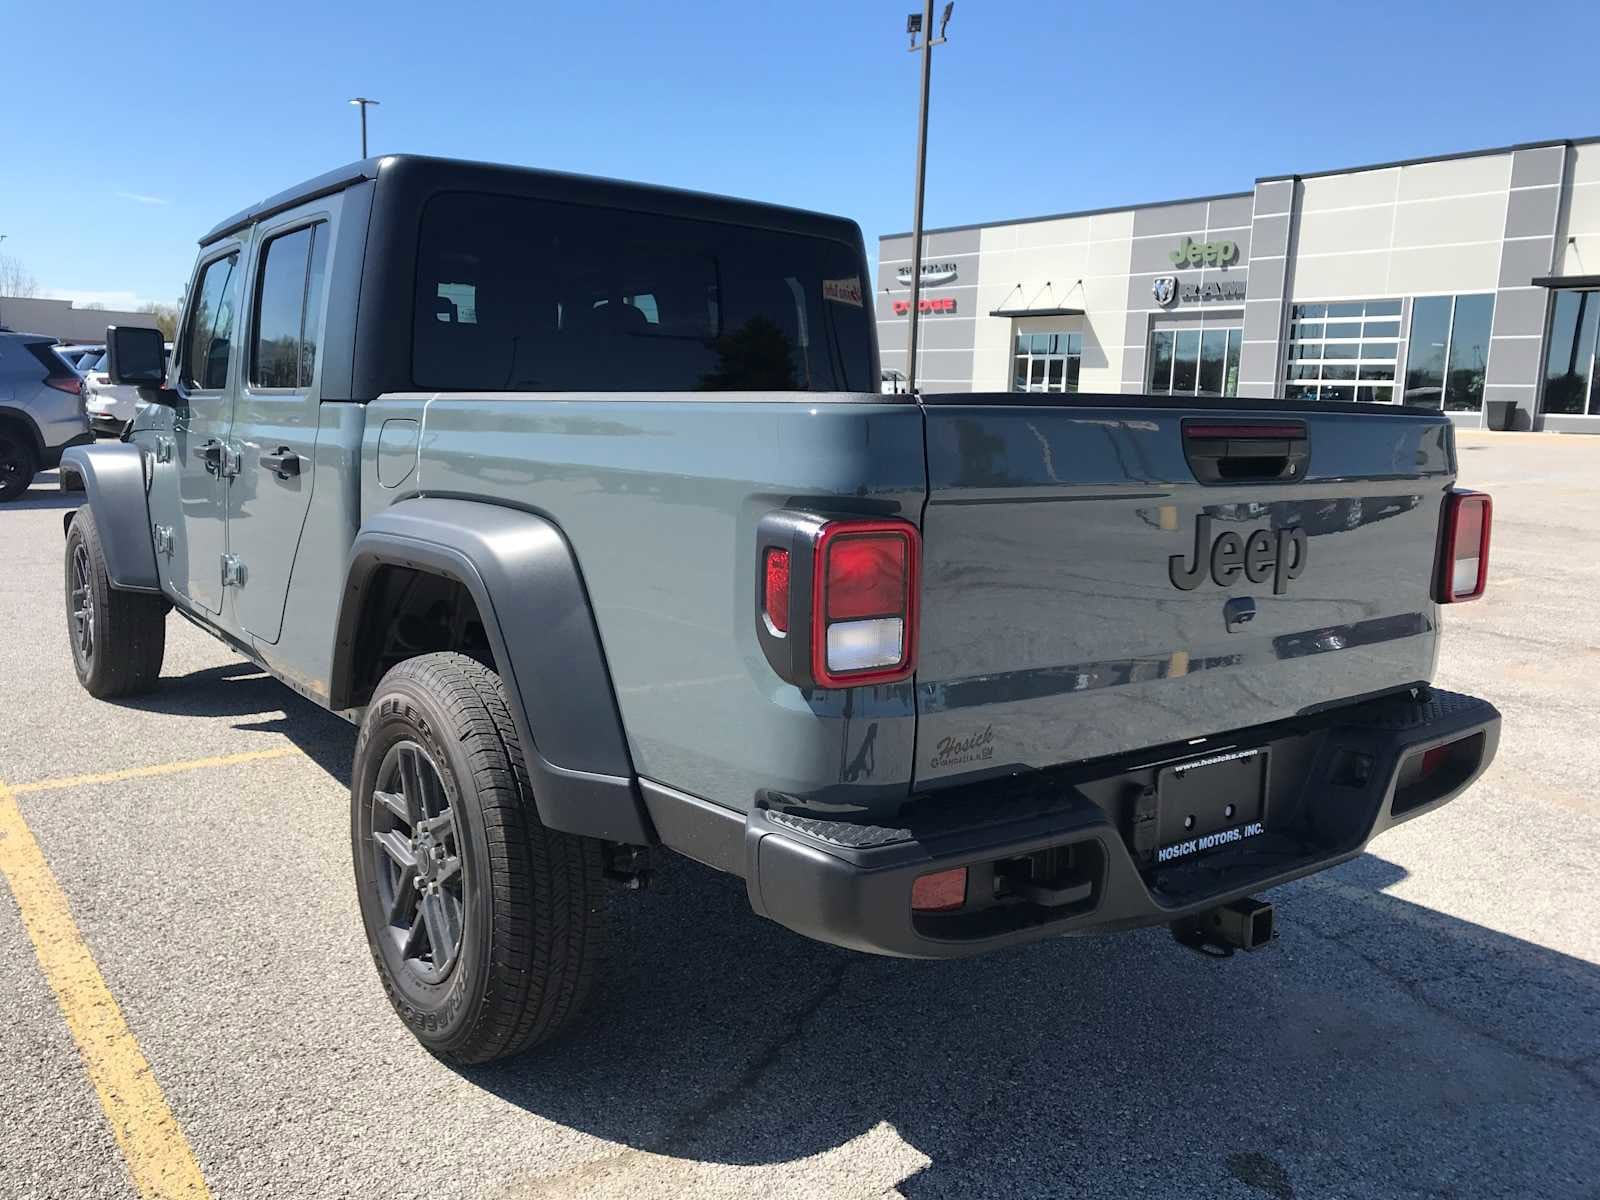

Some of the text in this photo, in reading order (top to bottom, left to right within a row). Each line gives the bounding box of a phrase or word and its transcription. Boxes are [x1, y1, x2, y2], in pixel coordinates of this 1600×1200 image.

[1168, 239, 1234, 267] Jeep
[1181, 281, 1247, 298] RAM
[1168, 513, 1308, 595] Jeep
[936, 723, 994, 760] Hosick
[1158, 822, 1265, 863] HOSICK MOTORS, INC.
